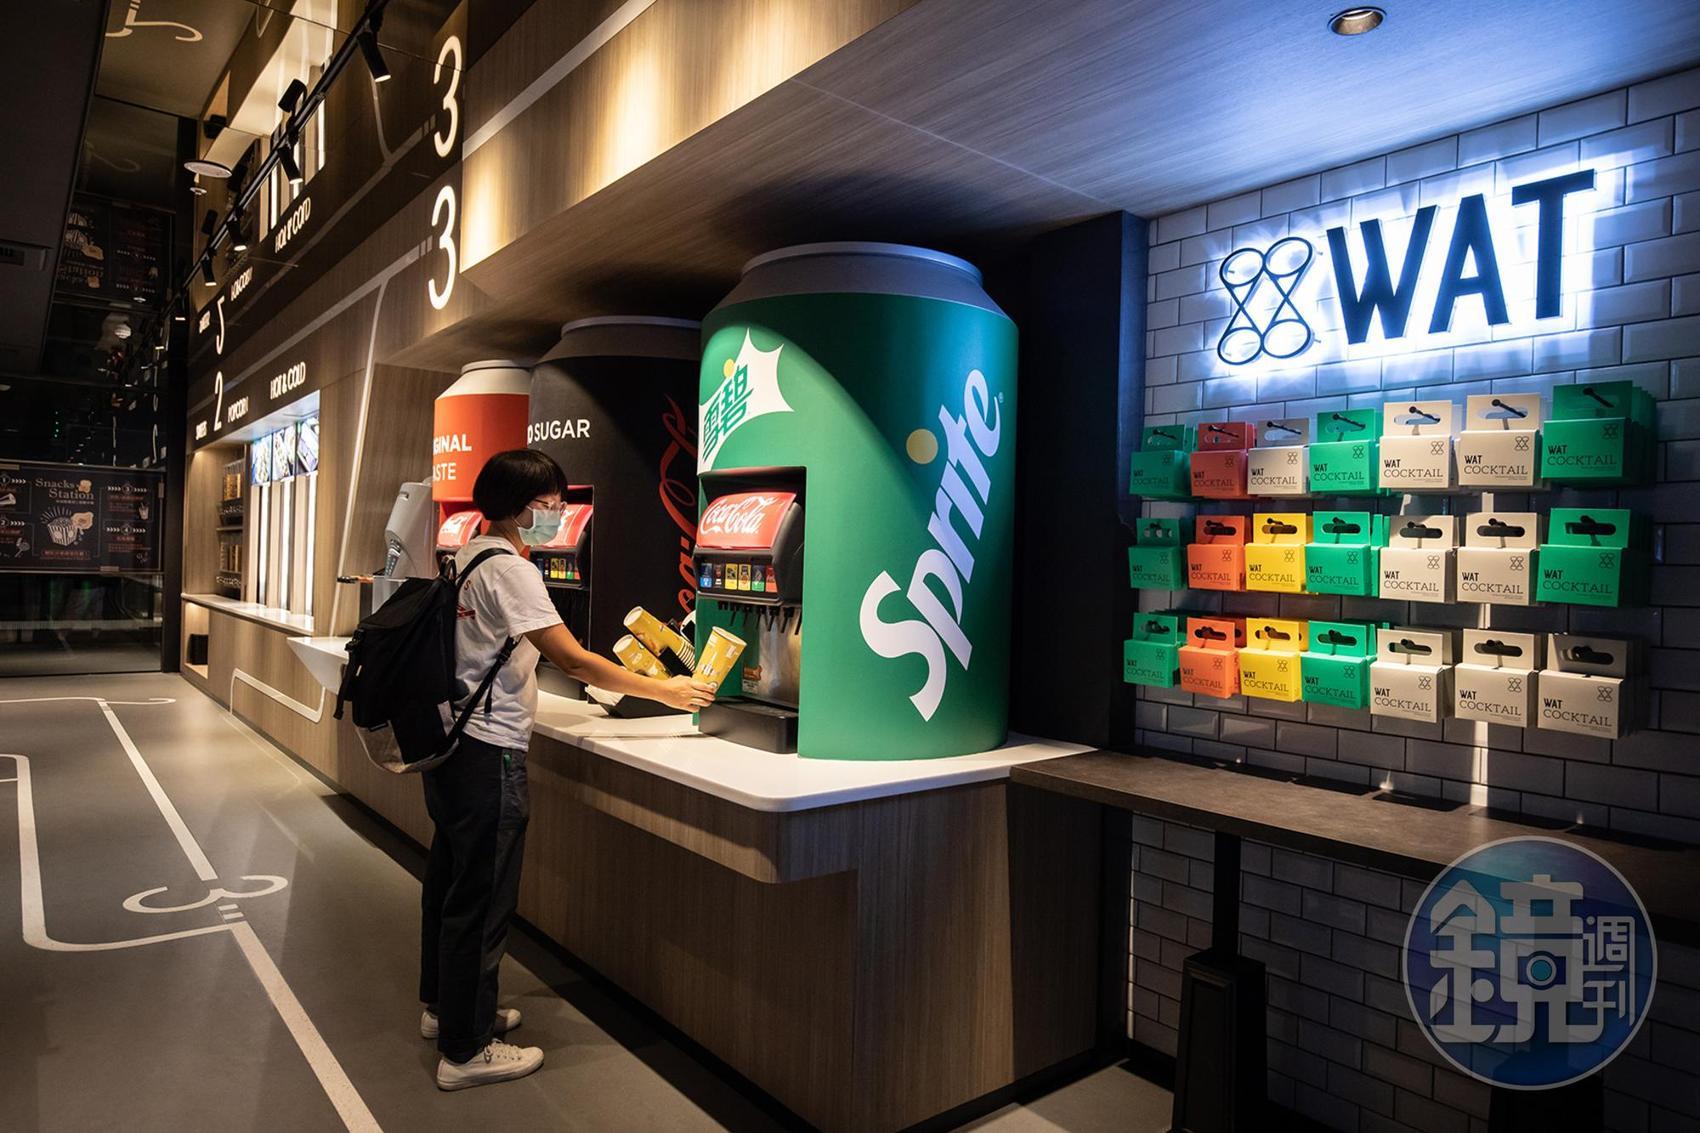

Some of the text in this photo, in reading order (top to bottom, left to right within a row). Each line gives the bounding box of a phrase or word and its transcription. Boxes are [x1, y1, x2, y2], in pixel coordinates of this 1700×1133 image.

[428, 185, 457, 310] 3
[1326, 168, 1597, 345] WAT
[270, 375, 282, 400] HOT
[287, 361, 306, 390] COLD
[214, 371, 223, 432] 2
[703, 363, 754, 463] 雪碧
[534, 419, 591, 442] SUGAR
[1548, 445, 1567, 455] WAT
[1384, 459, 1400, 468] WAT
[1465, 455, 1482, 464] WAT
[1547, 455, 1617, 466] COCKTAIL
[1251, 468, 1264, 476] WAT
[1314, 464, 1327, 472] WAT
[1464, 465, 1528, 475] COCKTAIL
[1194, 471, 1204, 479] WAT
[1314, 471, 1364, 481] COCKTAIL
[1384, 469, 1443, 478] COCKTAIL
[35, 478, 75, 489] Snacks
[1133, 476, 1169, 485] COCKTAIL
[1194, 478, 1234, 487] COCKTAIL
[1251, 476, 1297, 485] COCKTAIL
[48, 488, 95, 500] Station
[859, 369, 1001, 722] Sprite
[1192, 564, 1202, 572] WAT
[1250, 564, 1262, 573] WAT
[1310, 566, 1323, 575] WAT
[1132, 573, 1169, 582] COCKTAIL
[1192, 572, 1231, 581] COCKTAIL
[1250, 573, 1295, 582] COCKTAIL
[1309, 575, 1358, 585] COCKTAIL
[1384, 571, 1399, 580] WAT
[1462, 572, 1479, 582] WAT
[1544, 570, 1563, 580] WAT
[1384, 580, 1439, 592] COCKTAIL
[1462, 583, 1523, 594] COCKTAIL
[1543, 580, 1613, 594] COCKTAIL
[1127, 667, 1164, 679] COCKTAIL
[1244, 672, 1255, 680] WAT
[1183, 676, 1223, 689] COCKTAIL
[1244, 679, 1289, 692] COCKTAIL
[1305, 677, 1319, 685] WAT
[1305, 686, 1354, 699] COCKTAIL
[1375, 688, 1390, 697] WAT
[1460, 690, 1476, 699] WAT
[1375, 697, 1431, 712] COCKTAIL
[1460, 700, 1521, 716] COCKTAIL
[1544, 698, 1563, 709] WAT
[1544, 709, 1612, 727] COCKTAIL
